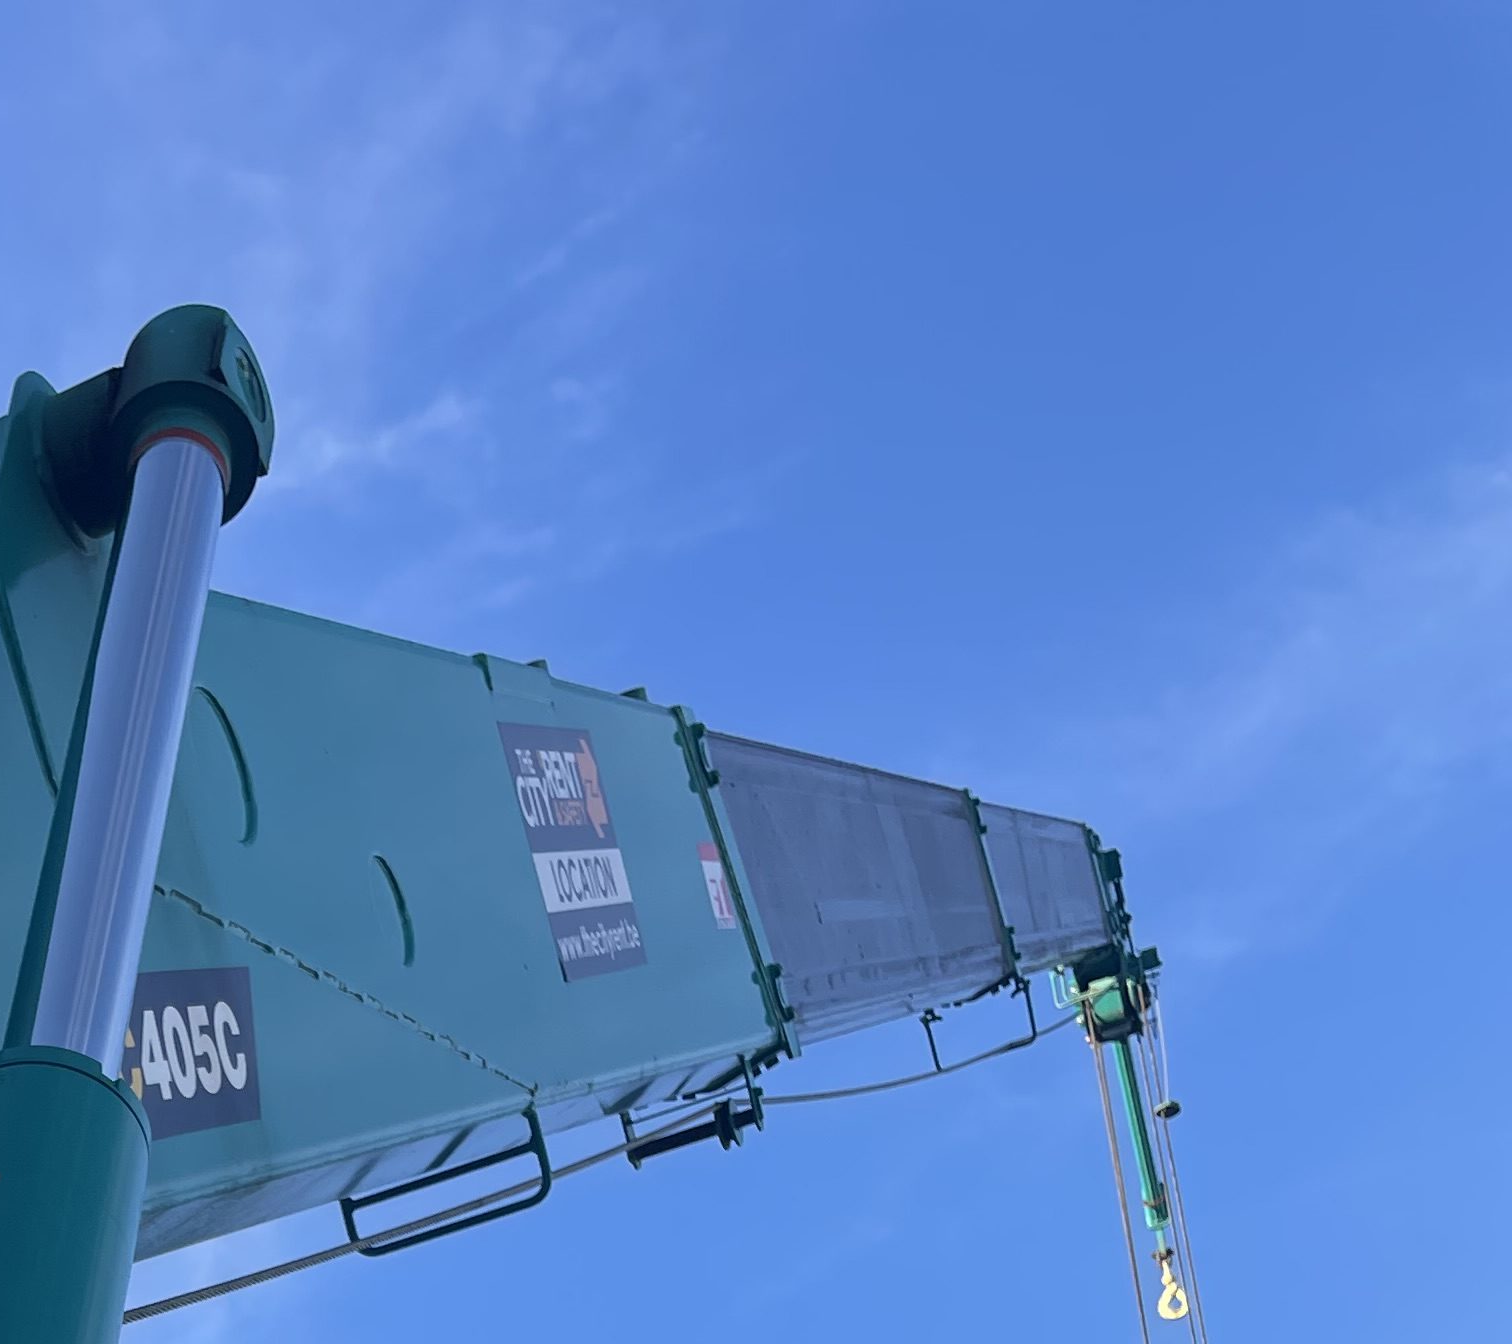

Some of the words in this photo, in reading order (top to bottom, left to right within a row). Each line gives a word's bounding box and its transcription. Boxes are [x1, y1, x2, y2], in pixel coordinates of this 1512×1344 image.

[540, 750, 584, 800] RENT
[516, 776, 556, 828] CITY
[550, 855, 619, 903] LOCATION
